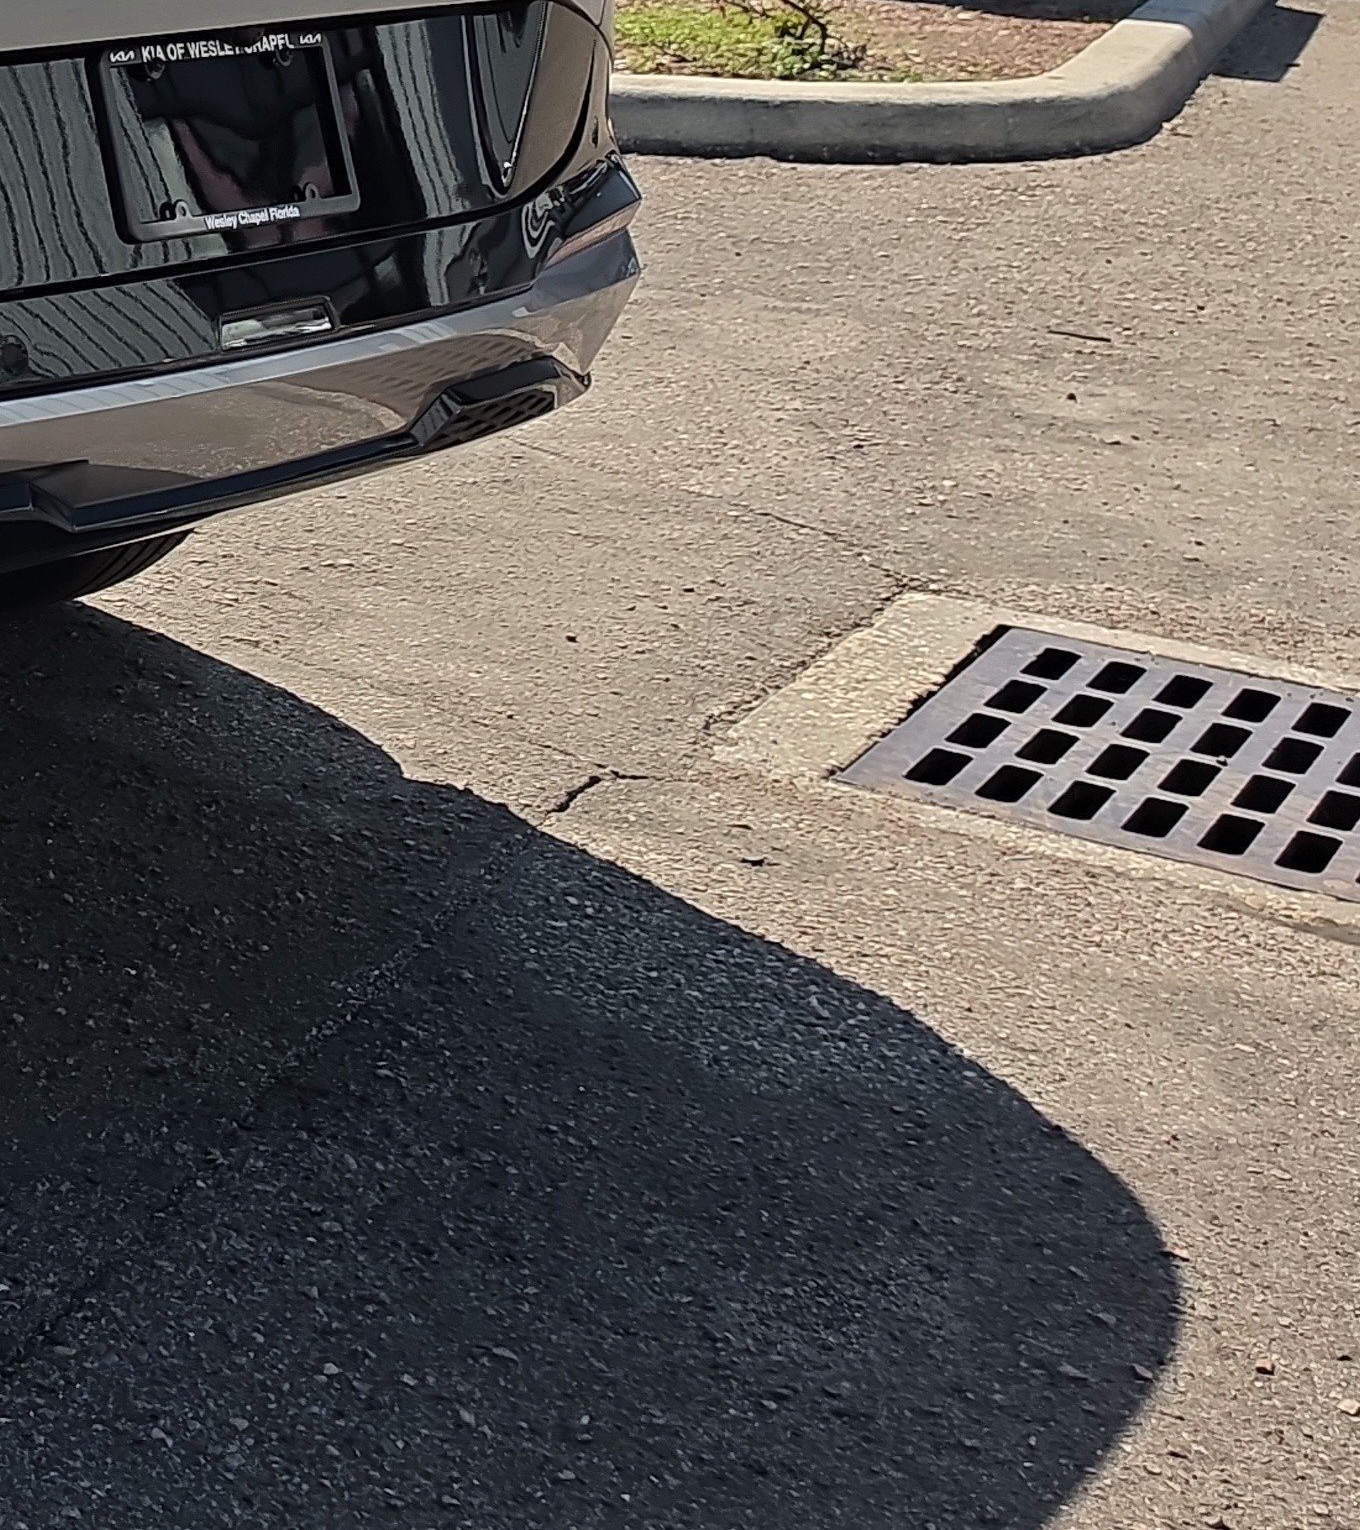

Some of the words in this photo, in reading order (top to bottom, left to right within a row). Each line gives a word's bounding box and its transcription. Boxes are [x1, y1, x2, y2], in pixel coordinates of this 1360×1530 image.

[141, 44, 166, 63] KIA
[166, 42, 185, 61] OF
[204, 215, 238, 230] Wesley
[238, 208, 269, 225] Chapel
[269, 204, 301, 222] Florida
